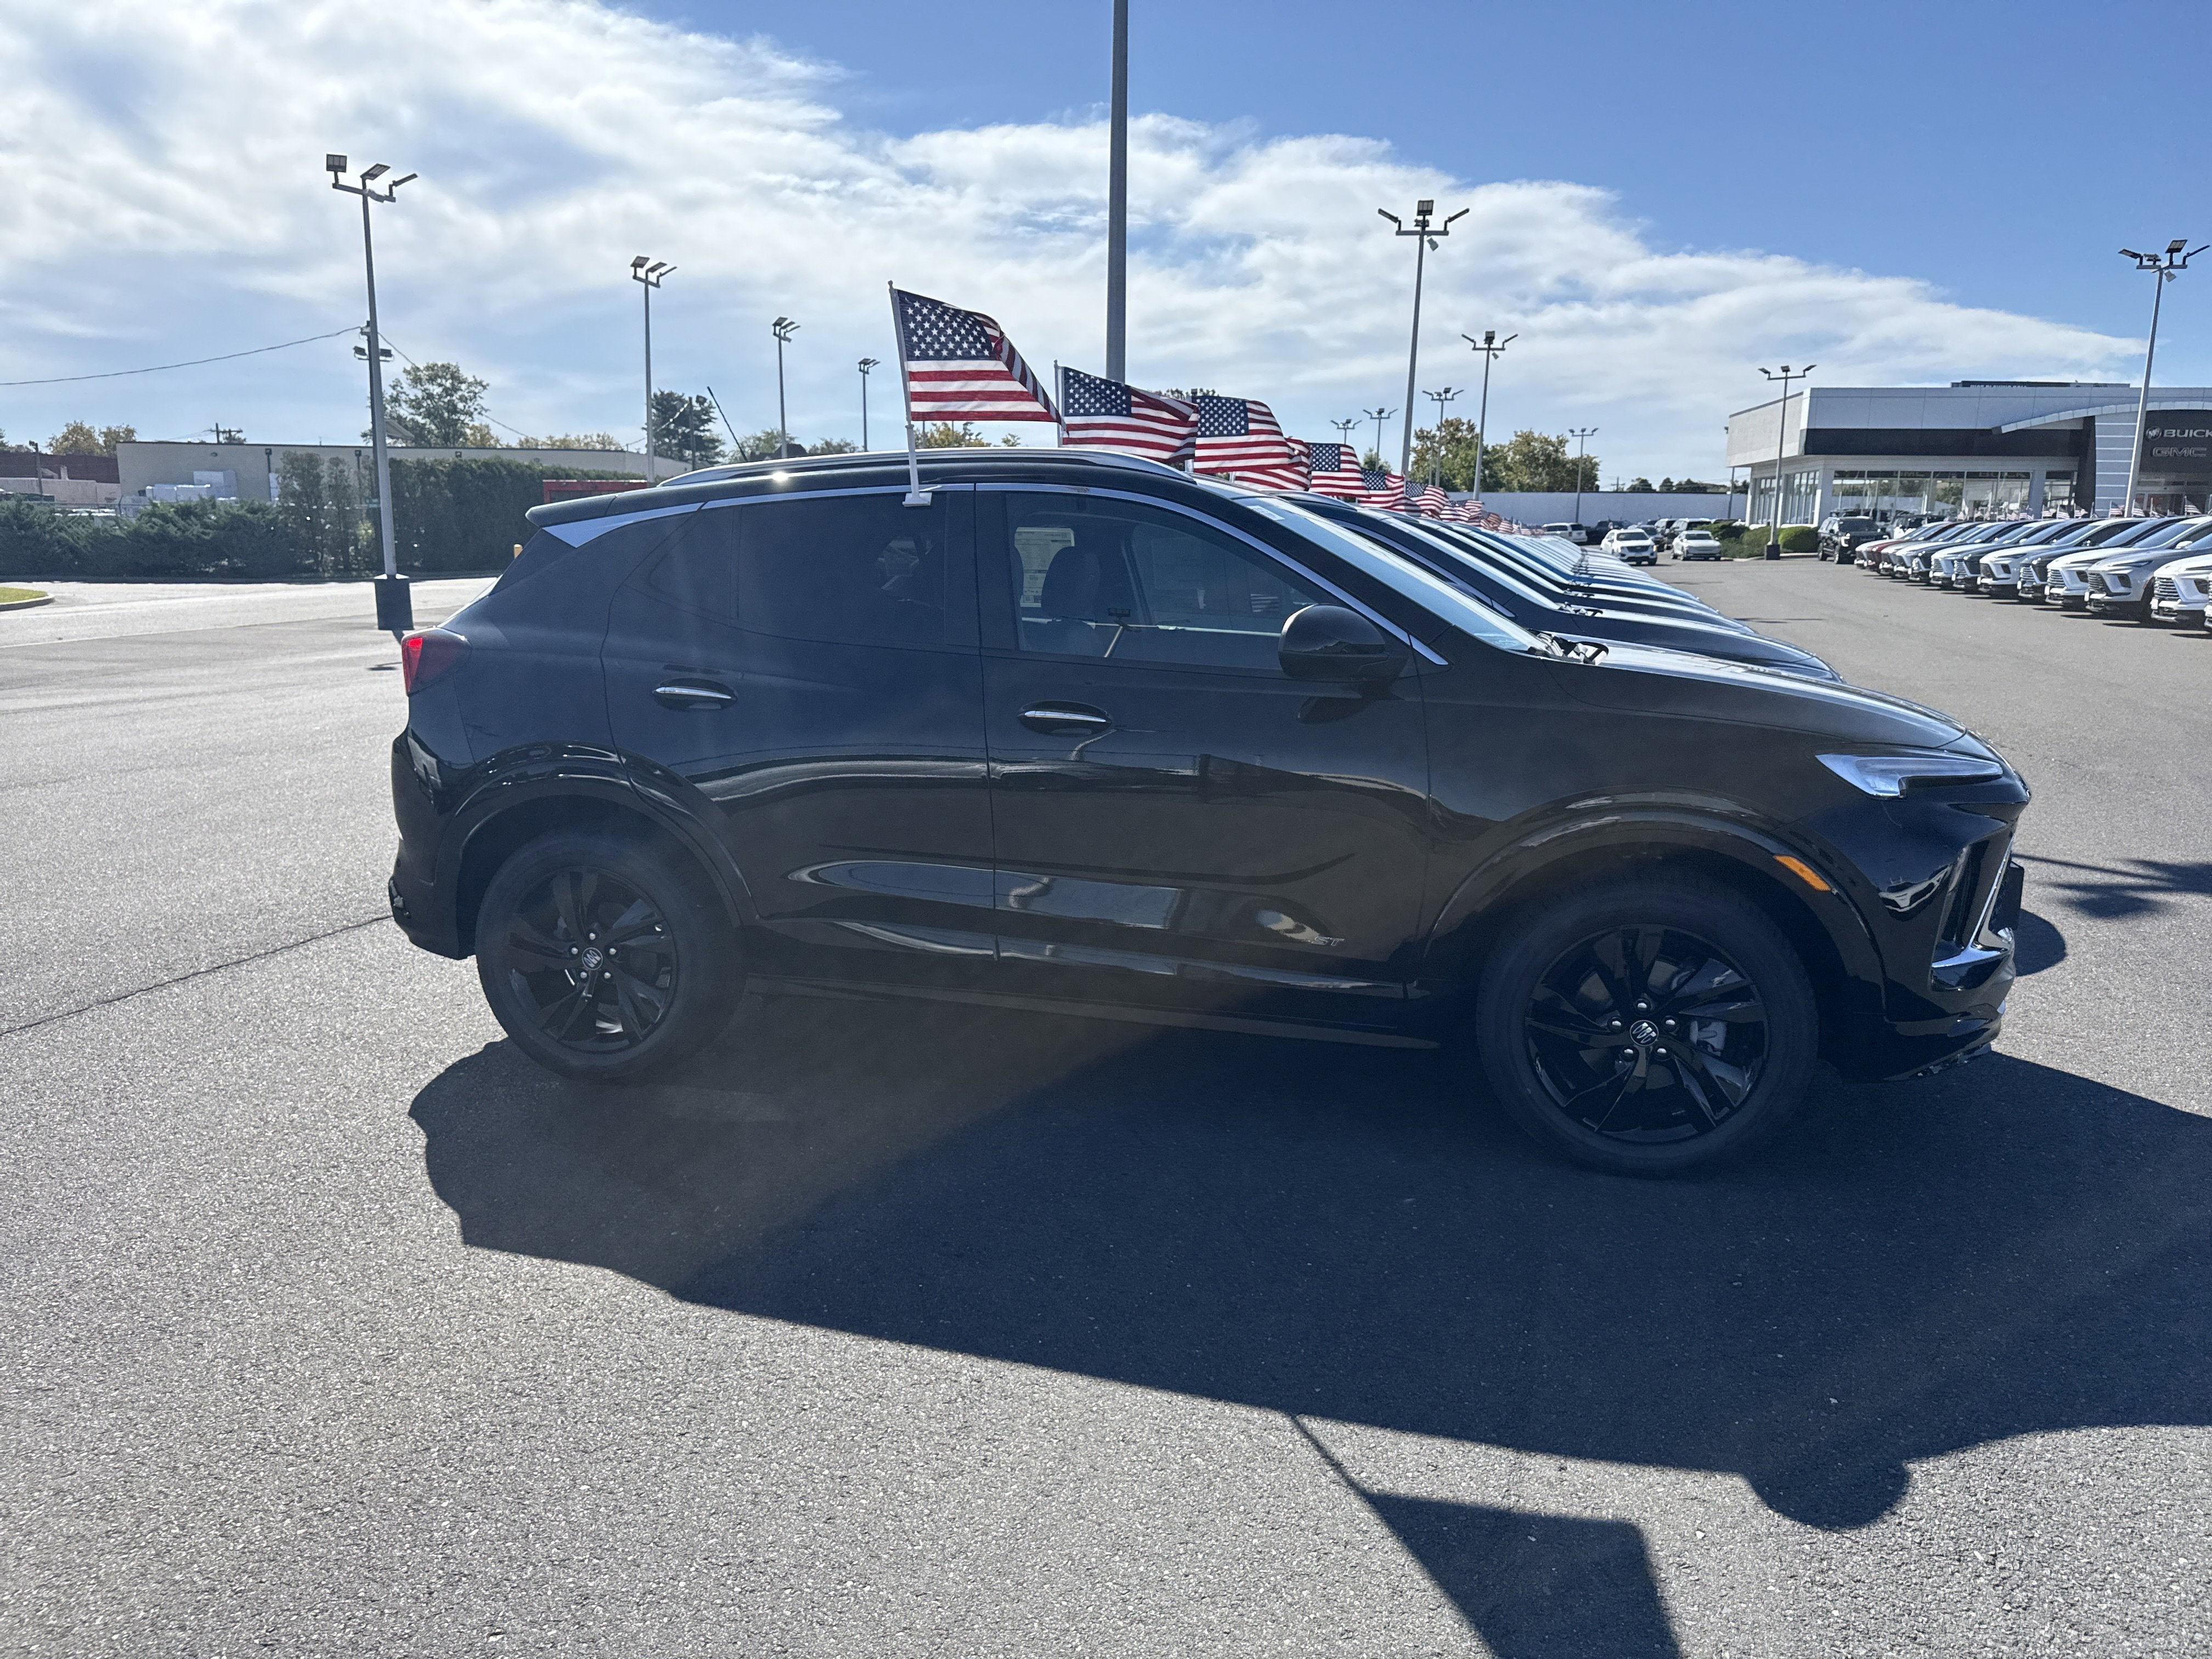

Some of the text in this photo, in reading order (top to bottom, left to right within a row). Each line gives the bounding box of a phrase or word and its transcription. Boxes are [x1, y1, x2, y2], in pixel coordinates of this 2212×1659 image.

[2164, 429, 2212, 437] BUICK
[2153, 447, 2207, 456] GMC
[1311, 936, 1345, 946] ST
